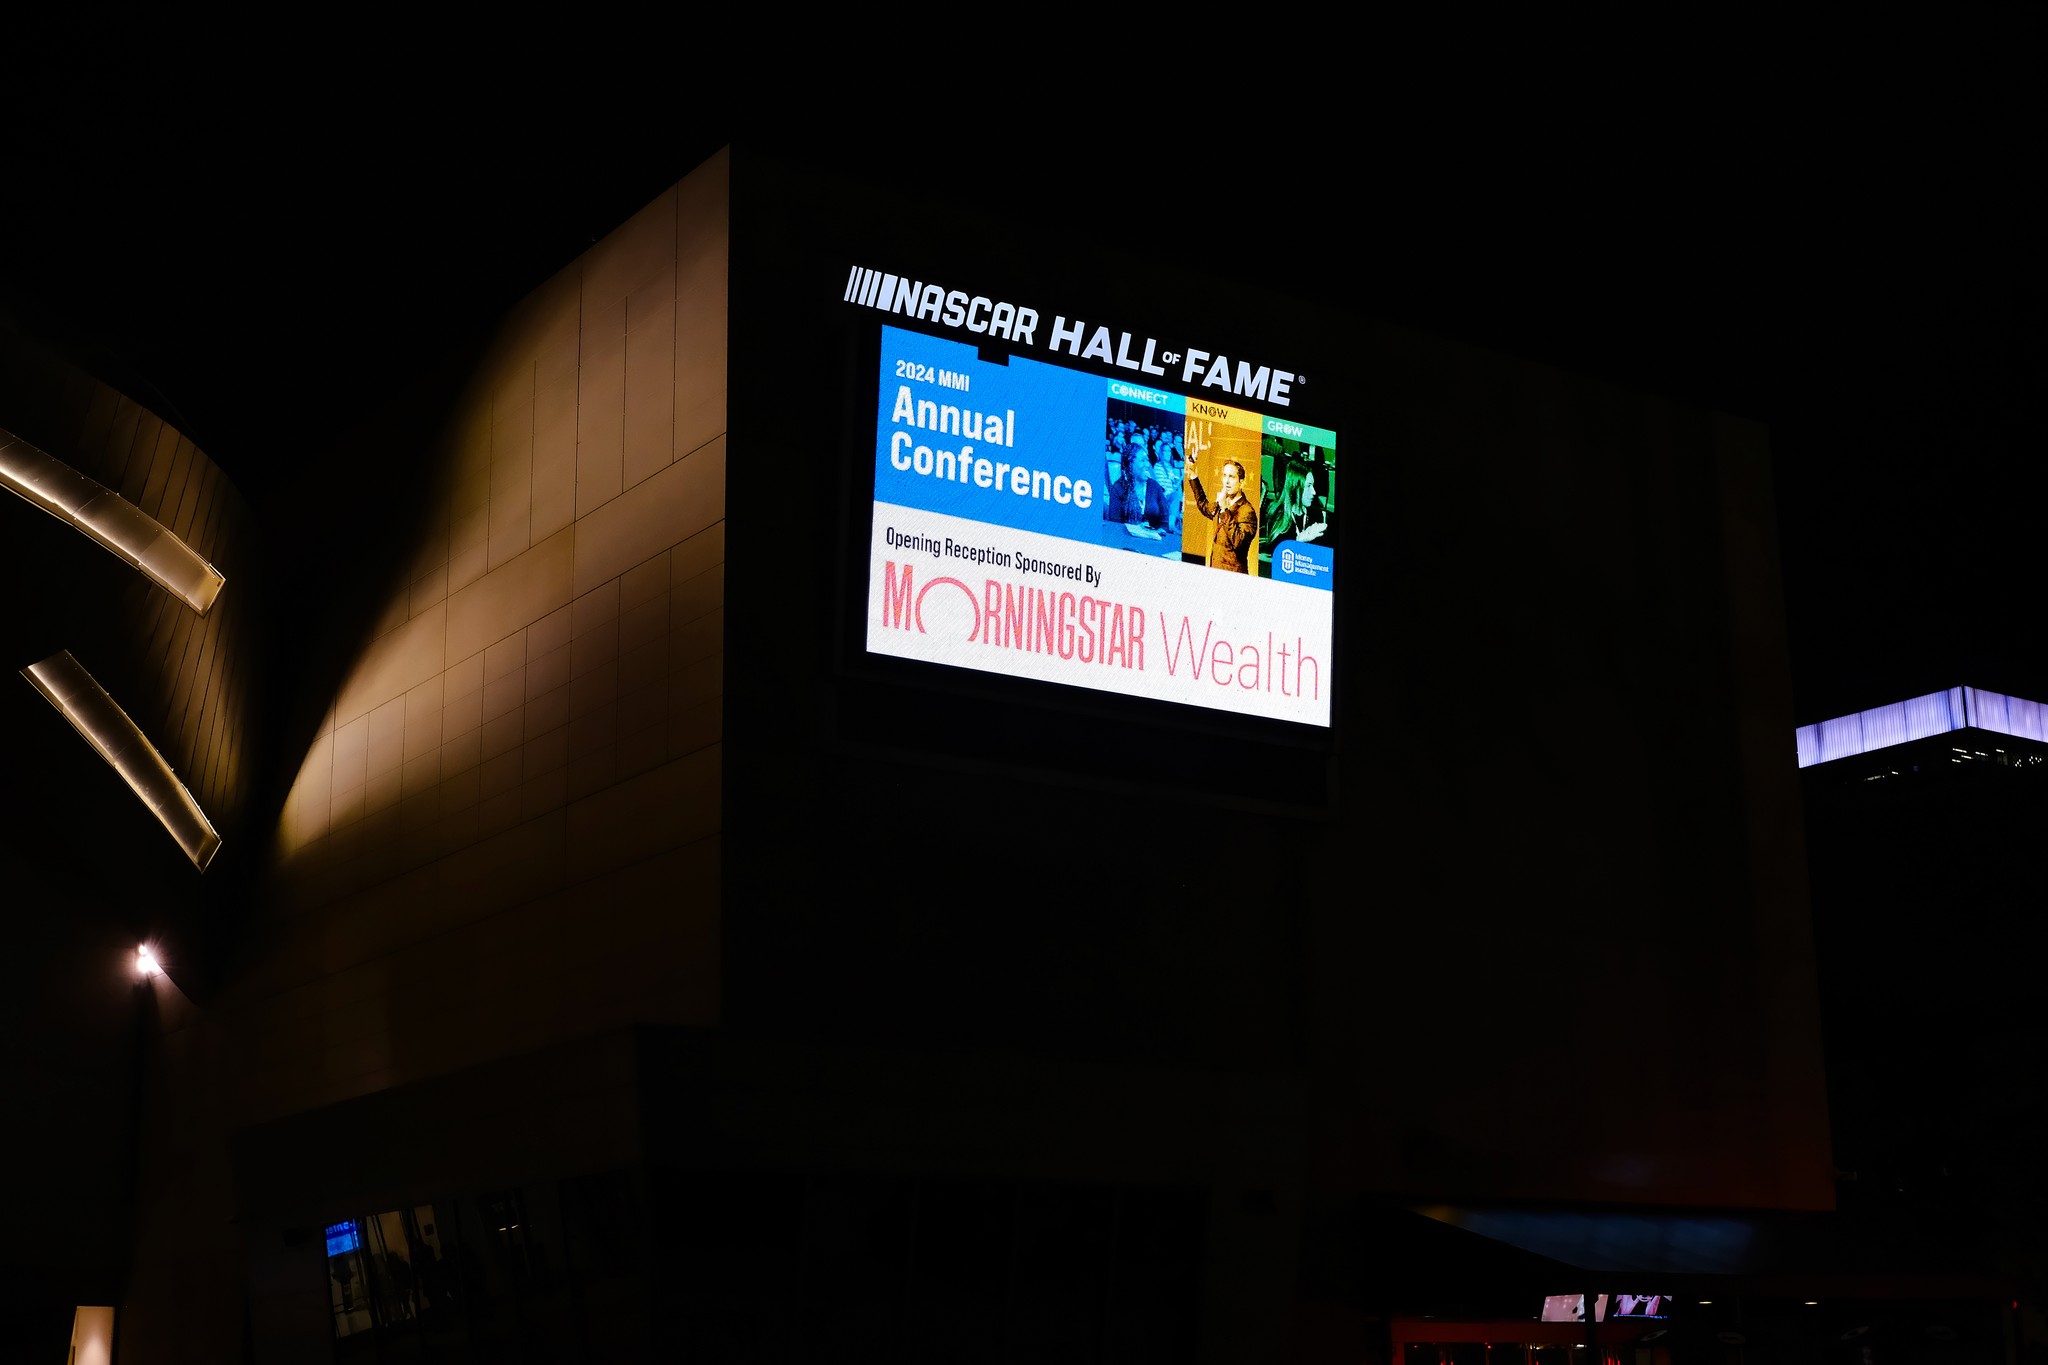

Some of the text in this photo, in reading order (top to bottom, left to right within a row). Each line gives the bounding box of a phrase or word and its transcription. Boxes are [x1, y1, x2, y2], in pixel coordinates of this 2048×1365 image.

[893, 276, 1039, 346] NASCAR
[1049, 315, 1165, 376] HALL
[1162, 350, 1181, 366] OF
[895, 359, 970, 392] 2024 MMI
[1111, 383, 1169, 405] CONNECT
[891, 385, 1015, 448] Annual
[1192, 402, 1229, 420] KNOW
[1267, 420, 1303, 438] GROW
[890, 431, 1093, 509] Conference
[886, 526, 1102, 588] Opening Reception Sponsored By
[882, 561, 1319, 701] MORNINGSTAR Wealth
